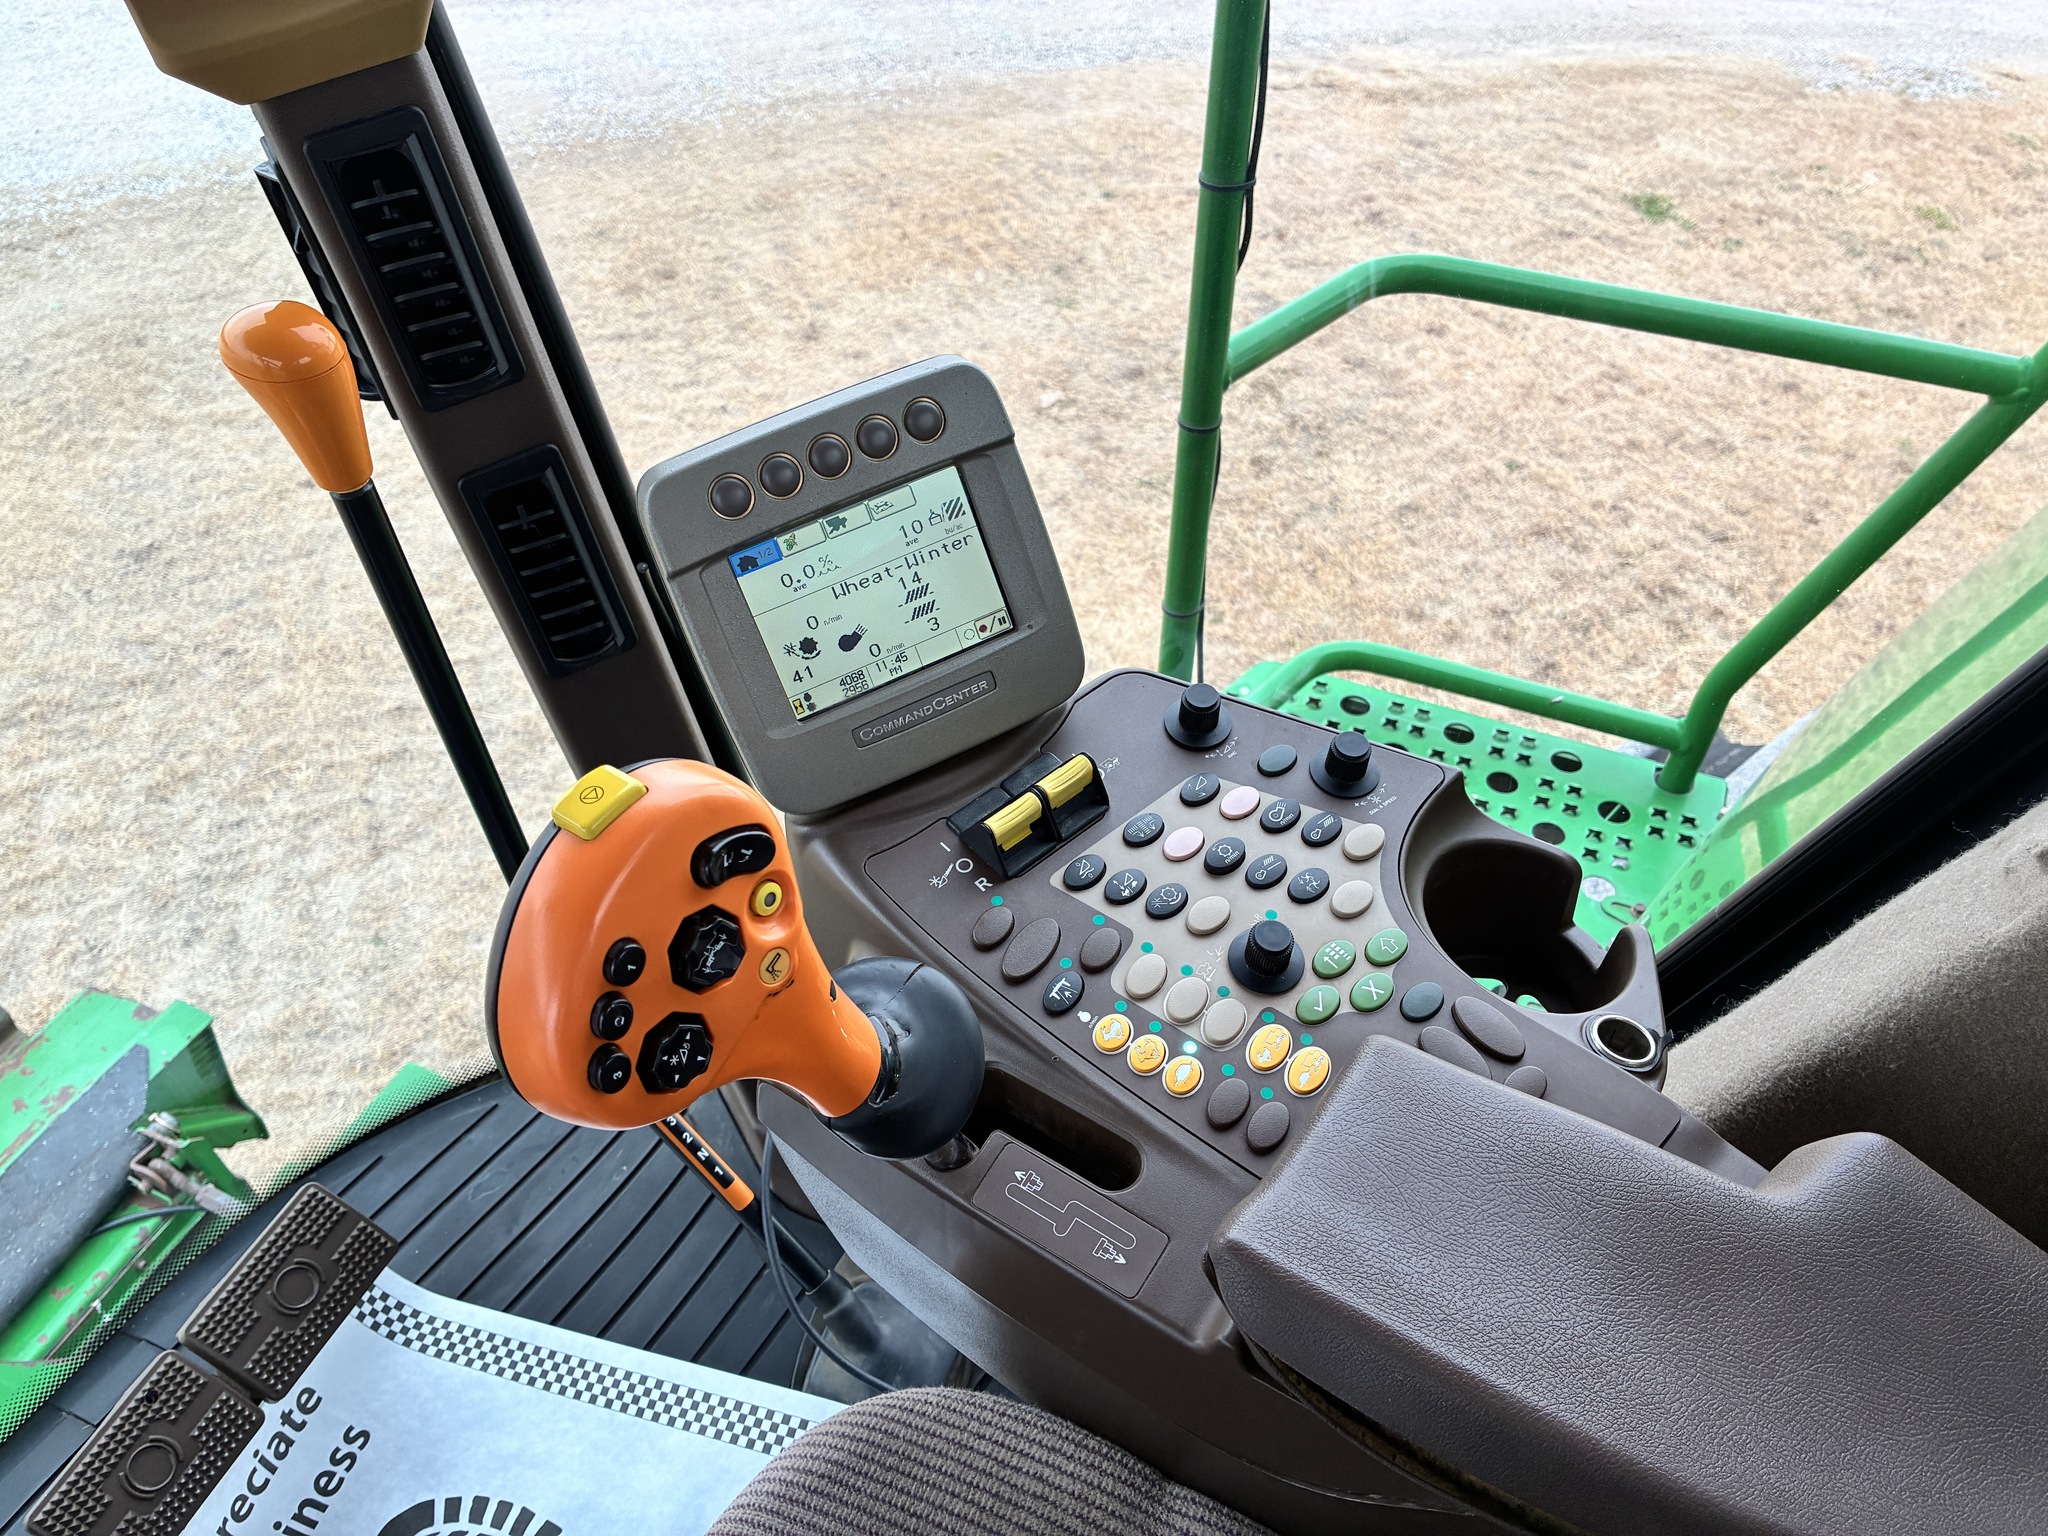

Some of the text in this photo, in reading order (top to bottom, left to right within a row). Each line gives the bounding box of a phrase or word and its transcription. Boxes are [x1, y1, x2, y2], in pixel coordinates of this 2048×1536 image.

[899, 519, 924, 539] 10
[944, 522, 964, 535] bu/ac
[905, 536, 919, 547] ave
[758, 547, 773, 559] 1/2
[831, 534, 974, 600] Wheat-Winter
[792, 582, 808, 593] ave
[897, 571, 922, 590] 14
[806, 613, 843, 630] 0 n/min
[926, 617, 940, 631] 3
[869, 643, 881, 658] 0
[793, 665, 814, 683] 41
[889, 664, 903, 677] PM
[839, 669, 866, 687] 4068
[842, 679, 870, 698] 2956
[974, 876, 993, 892] R
[666, 1116, 677, 1127] 3
[682, 1132, 694, 1144] 2
[714, 1165, 724, 1176] 1
